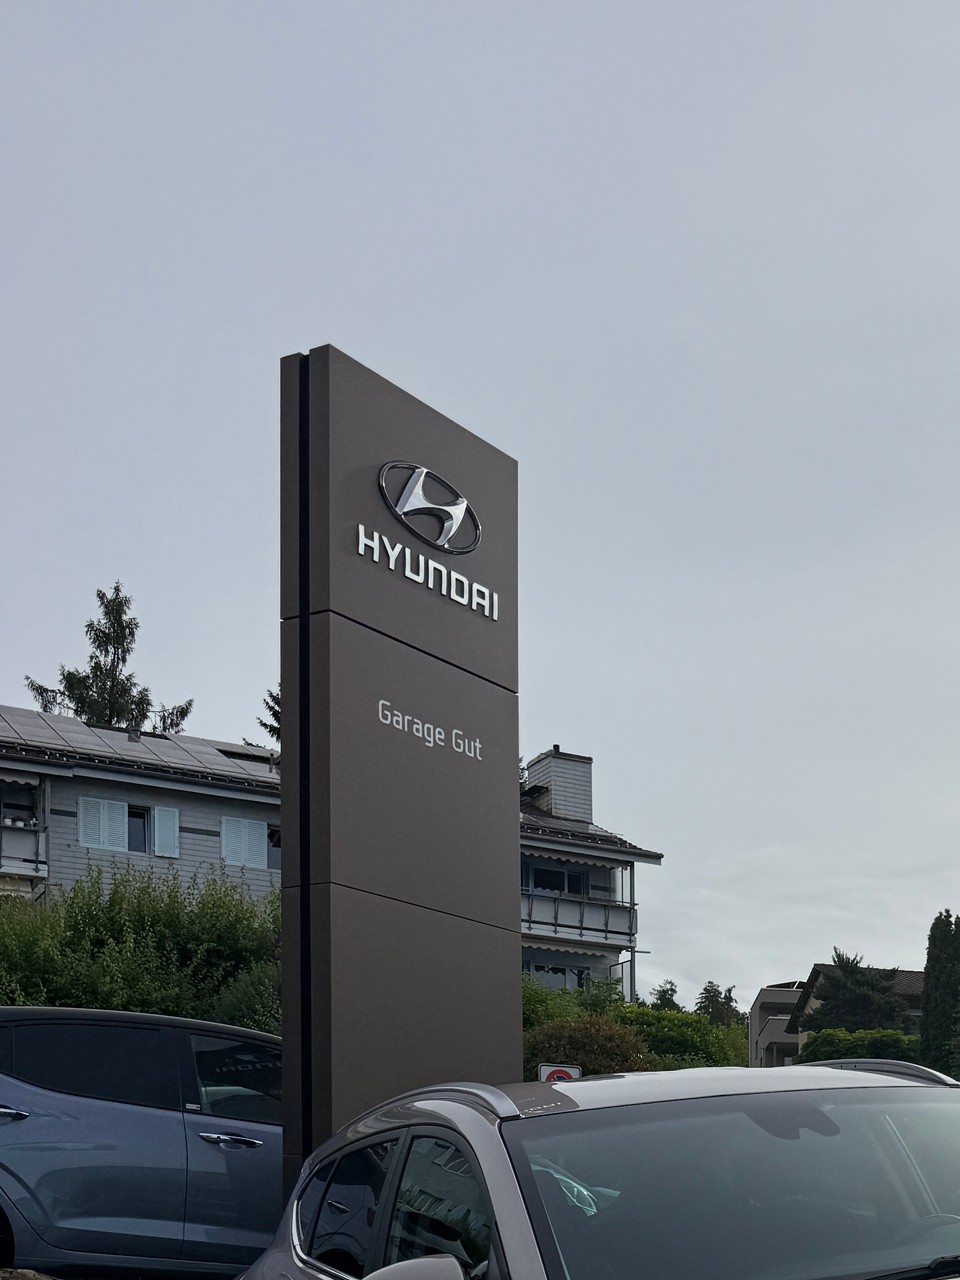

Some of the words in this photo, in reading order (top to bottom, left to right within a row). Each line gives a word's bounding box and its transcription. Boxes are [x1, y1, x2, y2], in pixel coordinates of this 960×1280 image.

[357, 523, 499, 621] HYUNDAI
[378, 699, 445, 747] Garage
[452, 729, 483, 760] Gut
